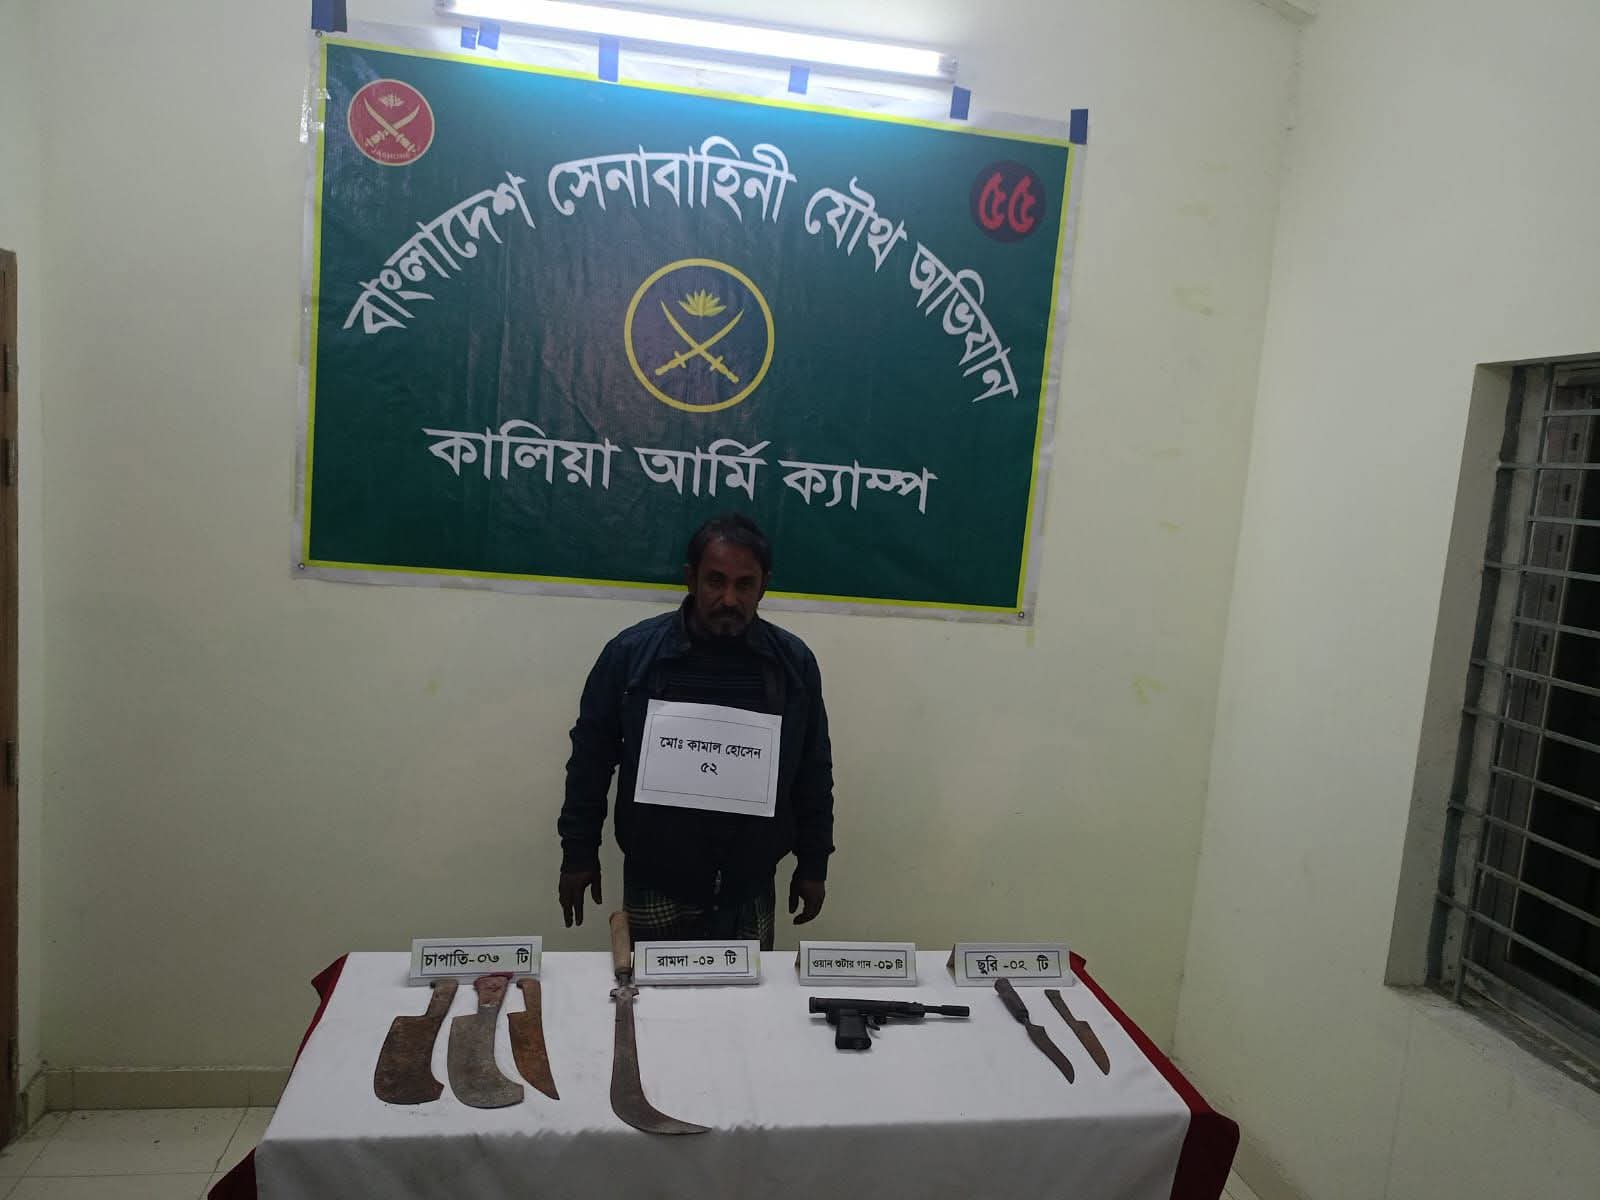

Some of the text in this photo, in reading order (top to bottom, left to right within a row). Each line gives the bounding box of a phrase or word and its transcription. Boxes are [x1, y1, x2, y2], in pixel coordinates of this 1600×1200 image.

[979, 171, 1037, 234] ৫৫
[343, 136, 1018, 402] বাংলাদেশ সেনাবাহিনী যৌথ অভিযান
[422, 419, 937, 515] কালিয়া আর্মি ক্যাম্প
[660, 736, 762, 759] মোঃ কামাল হোসেন
[700, 762, 718, 776] ৫২
[516, 948, 529, 966] টি
[657, 955, 689, 967] রামদা
[724, 949, 737, 966] টি
[812, 959, 833, 969] ওয়ান
[857, 959, 871, 969] গান
[895, 958, 904, 970] টি
[976, 954, 998, 975] ছুরি
[1036, 954, 1049, 972] টি
